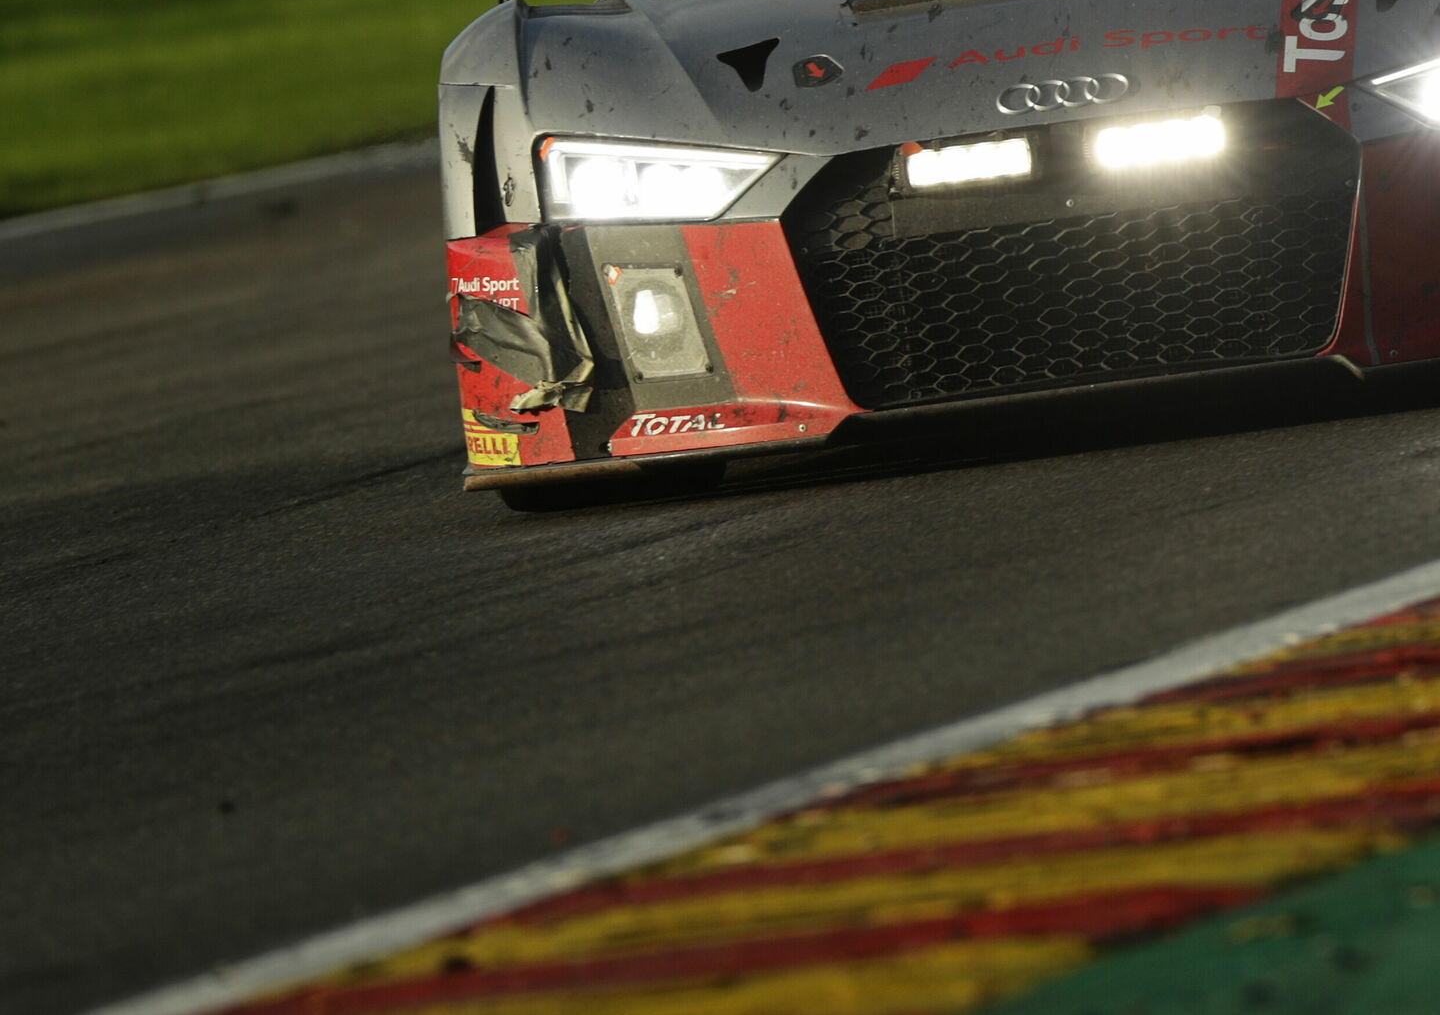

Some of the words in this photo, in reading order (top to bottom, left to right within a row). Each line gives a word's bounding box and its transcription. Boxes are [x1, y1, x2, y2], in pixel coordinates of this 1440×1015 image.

[948, 35, 1080, 69] Audi
[1103, 24, 1268, 50] Sport
[458, 276, 480, 293] Audi
[482, 276, 520, 296] Sport
[630, 413, 725, 437] TOTAL
